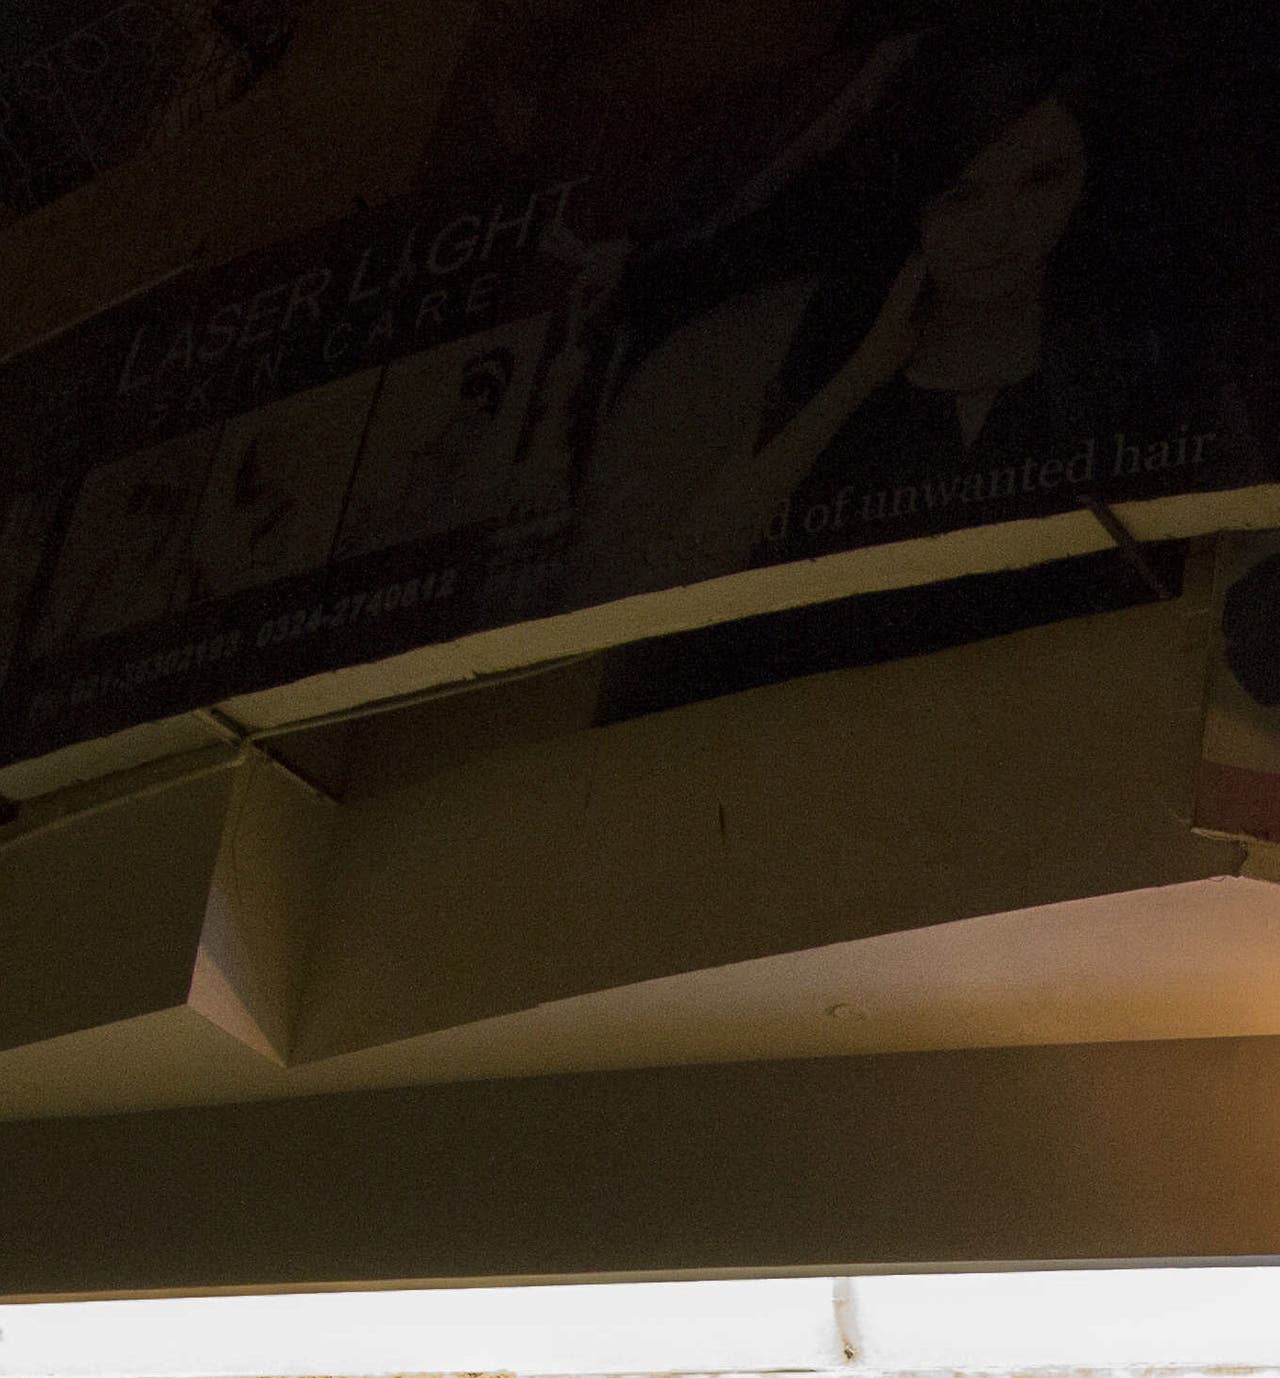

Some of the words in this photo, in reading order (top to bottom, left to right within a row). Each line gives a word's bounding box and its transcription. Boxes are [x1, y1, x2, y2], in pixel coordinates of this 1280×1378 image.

[117, 266, 333, 397] LASER
[346, 174, 592, 304] LIGHT
[322, 272, 500, 364] CARE
[802, 484, 856, 535] of
[859, 436, 1097, 524] unwanted
[1110, 422, 1218, 478] hair
